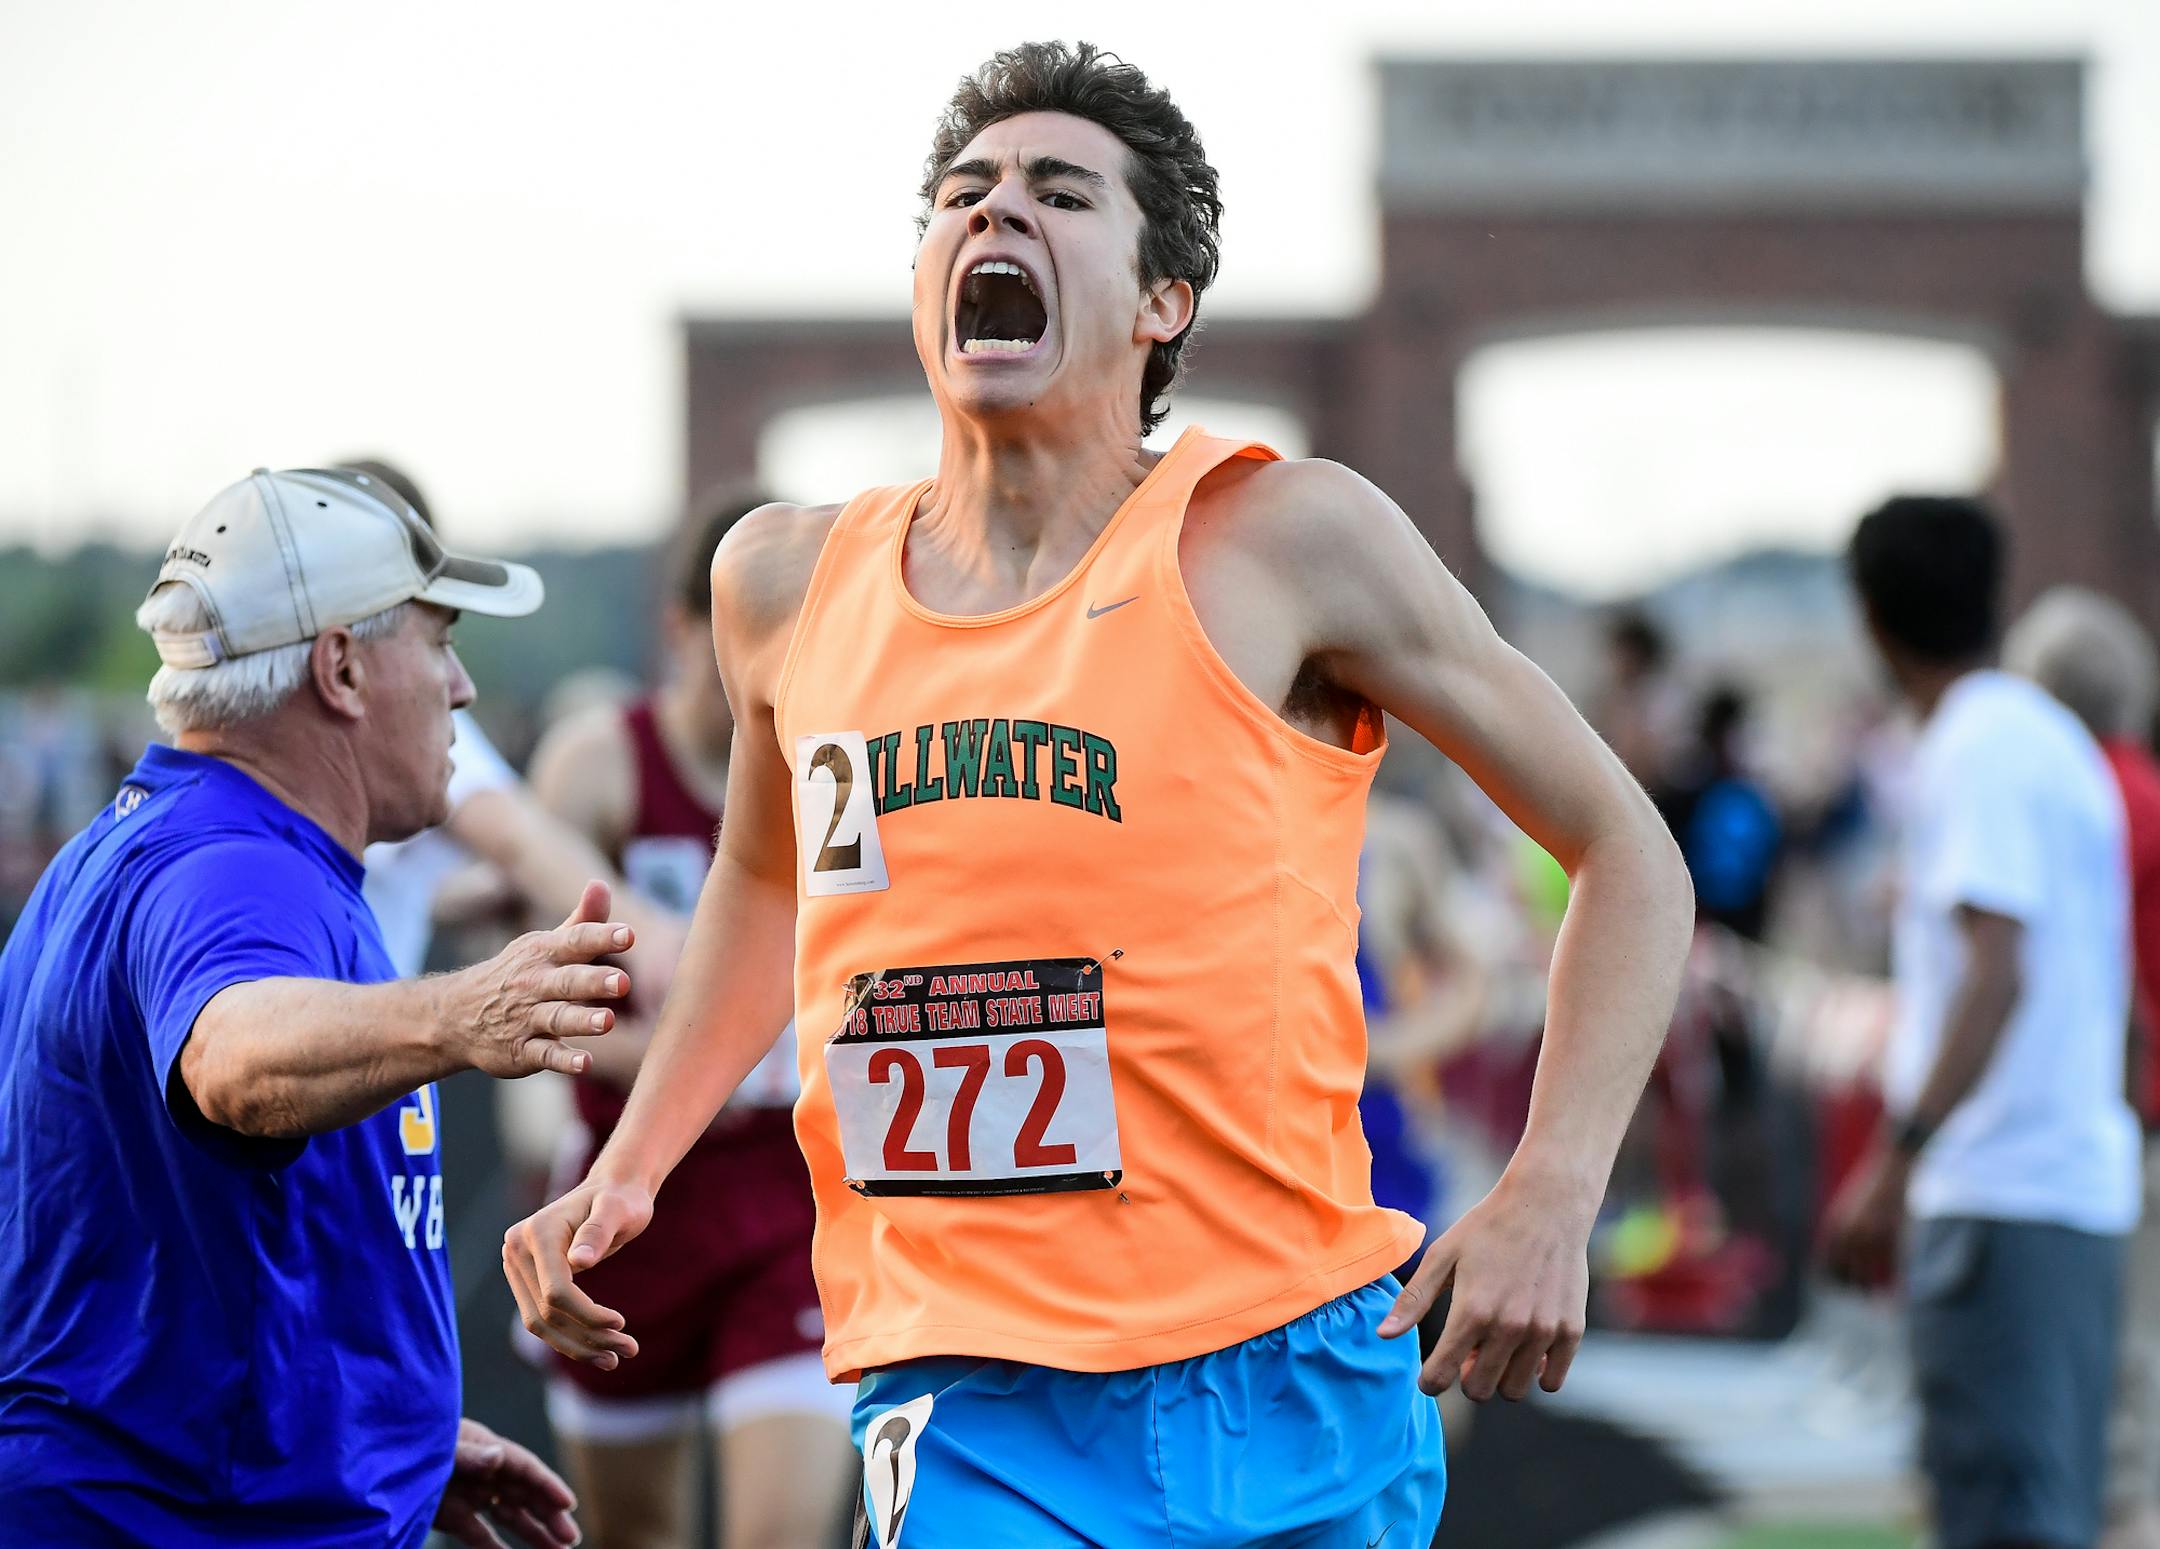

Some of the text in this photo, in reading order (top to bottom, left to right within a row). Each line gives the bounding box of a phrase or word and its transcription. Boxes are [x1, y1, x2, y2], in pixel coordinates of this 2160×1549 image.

[808, 743, 862, 873] 2
[872, 1003, 921, 1034] TRUE
[925, 999, 980, 1031] TEAM
[986, 996, 1042, 1027] STATE
[1049, 992, 1101, 1023] MEET
[928, 970, 1040, 996] ANNUAL
[867, 1038, 1078, 1172] 272
